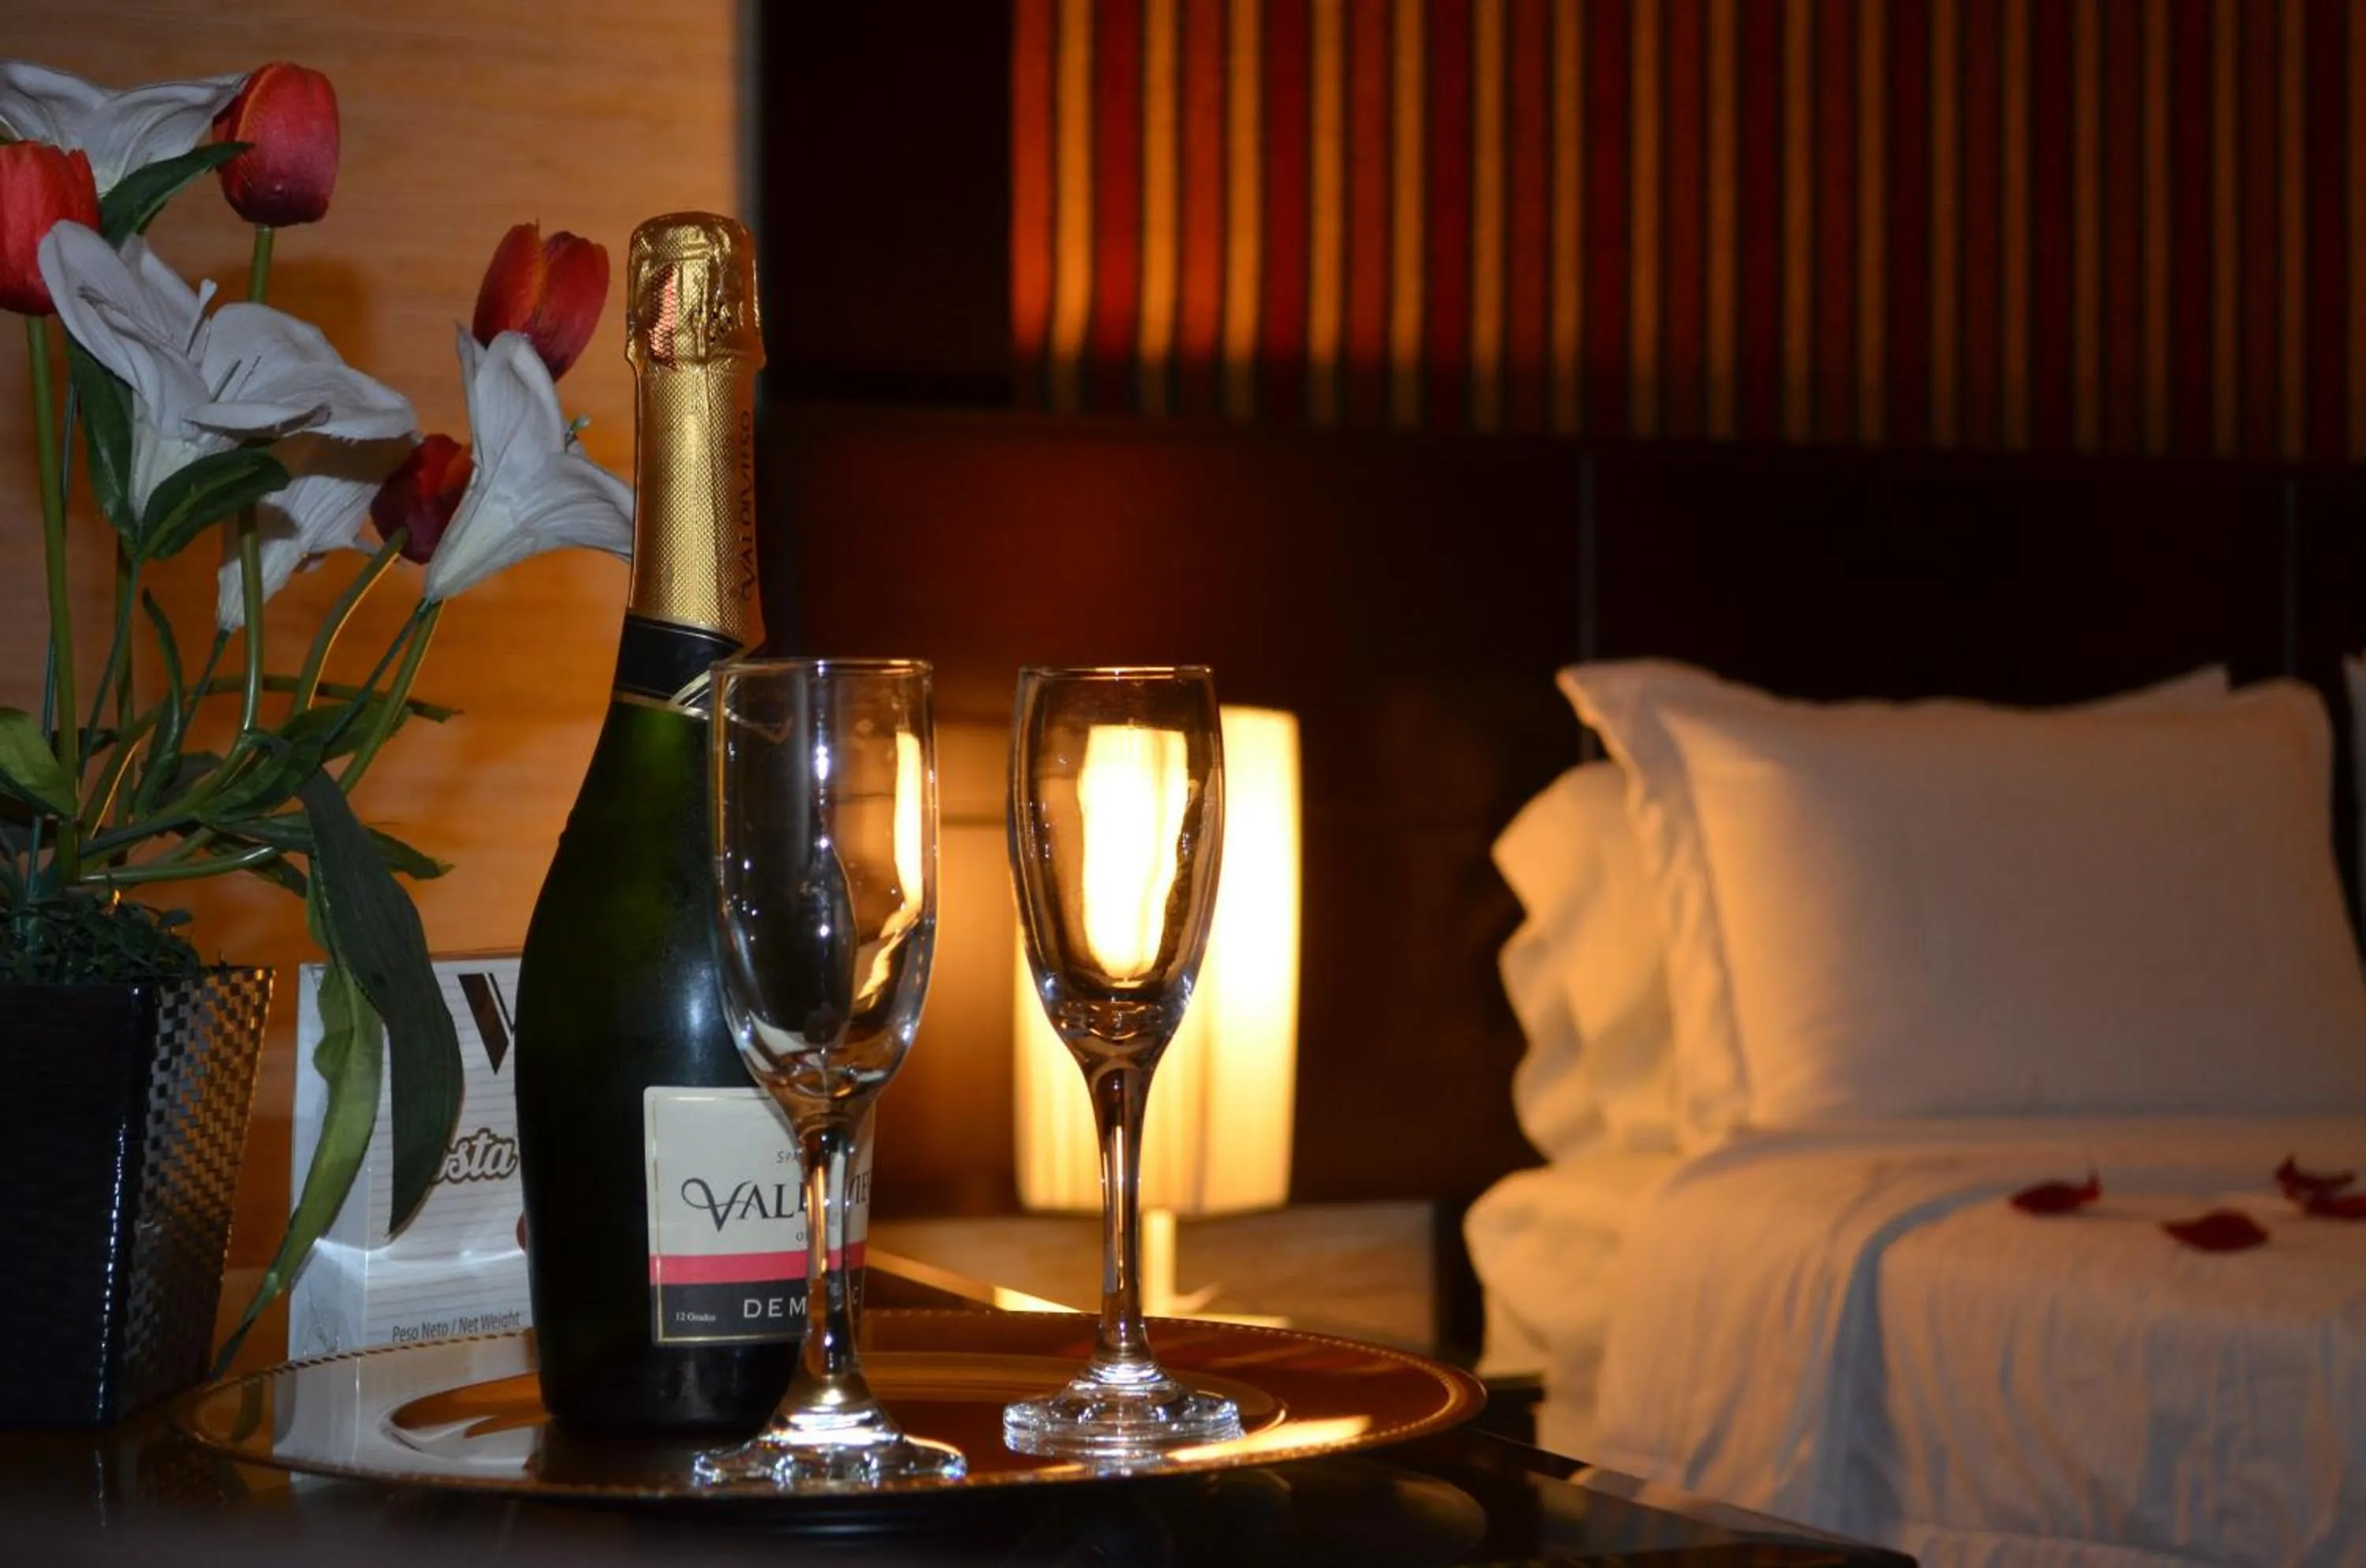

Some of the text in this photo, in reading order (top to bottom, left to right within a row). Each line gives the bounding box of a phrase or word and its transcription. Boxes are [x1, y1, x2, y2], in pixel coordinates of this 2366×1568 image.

[740, 411, 756, 601] VALDIVIESO
[437, 1128, 518, 1184] sta
[393, 1325, 419, 1342] Peso
[422, 1321, 448, 1338] Neto
[459, 1316, 479, 1334] Net
[480, 1310, 521, 1331] Weight
[744, 1297, 806, 1319] DEM
